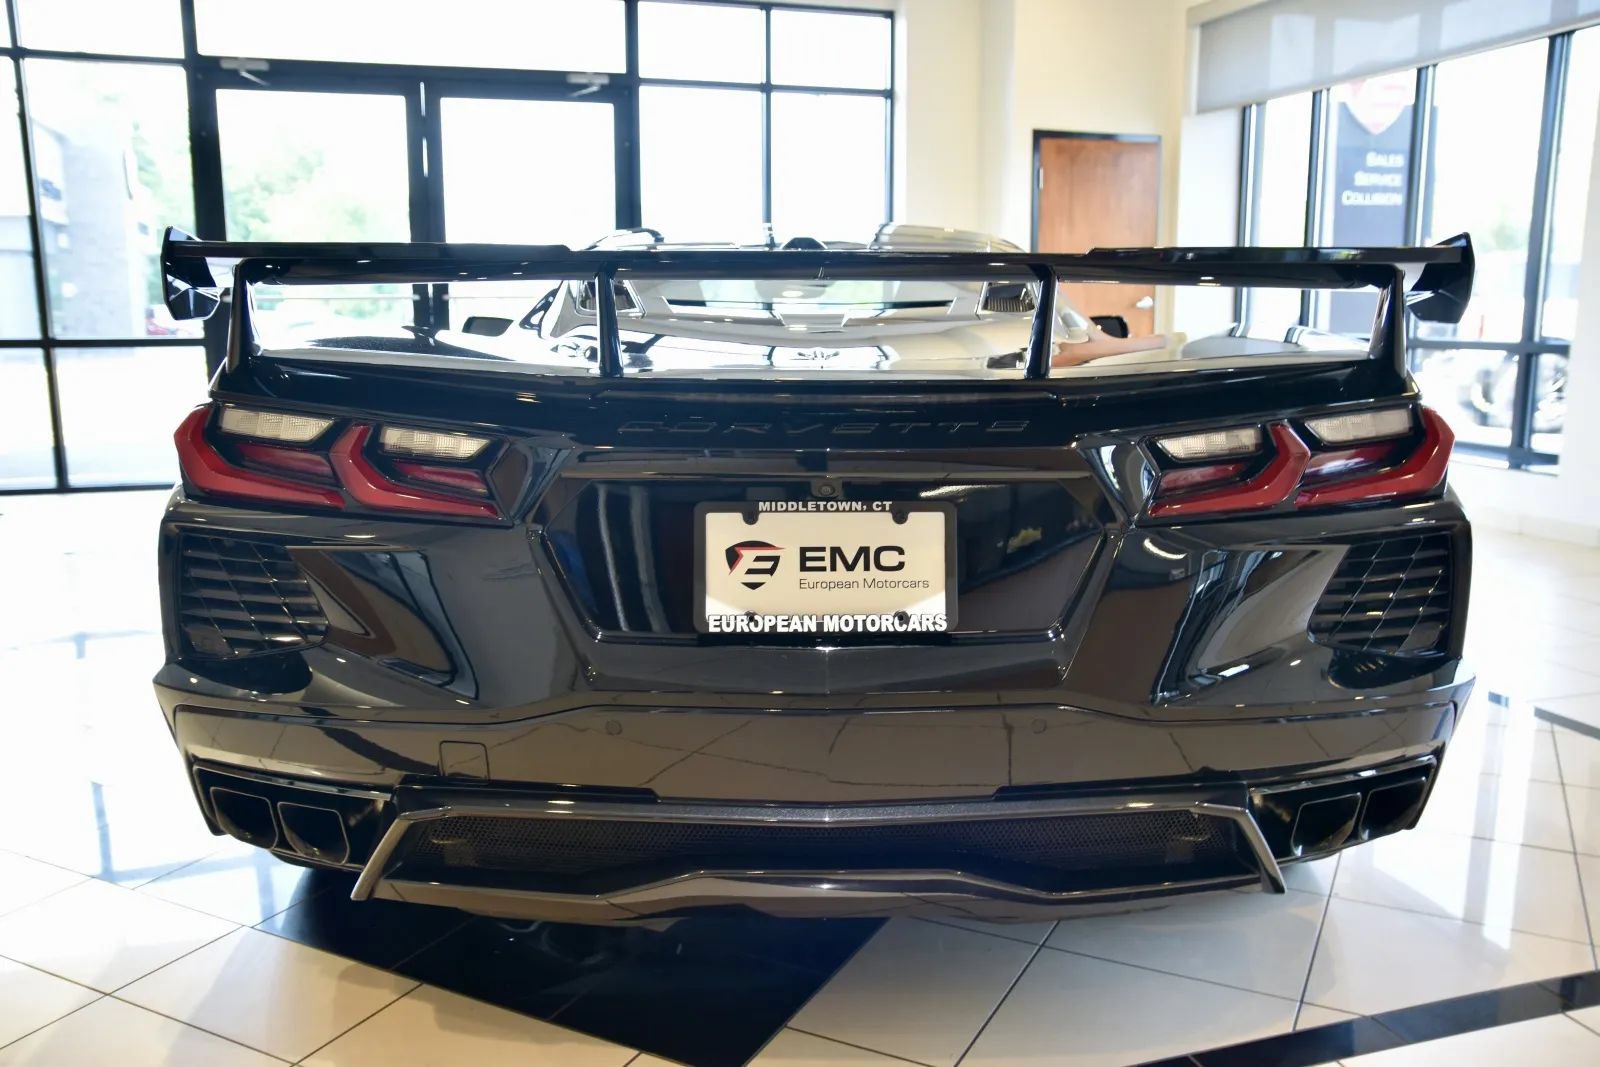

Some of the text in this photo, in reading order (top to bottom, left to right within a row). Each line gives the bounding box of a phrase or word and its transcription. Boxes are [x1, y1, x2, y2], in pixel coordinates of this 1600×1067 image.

[758, 501, 892, 511] MIDDLETOWN, CT
[799, 546, 905, 572] EMC
[800, 578, 929, 591] European Motorcars
[708, 613, 947, 632] EUROPEAN MOTORCARS
